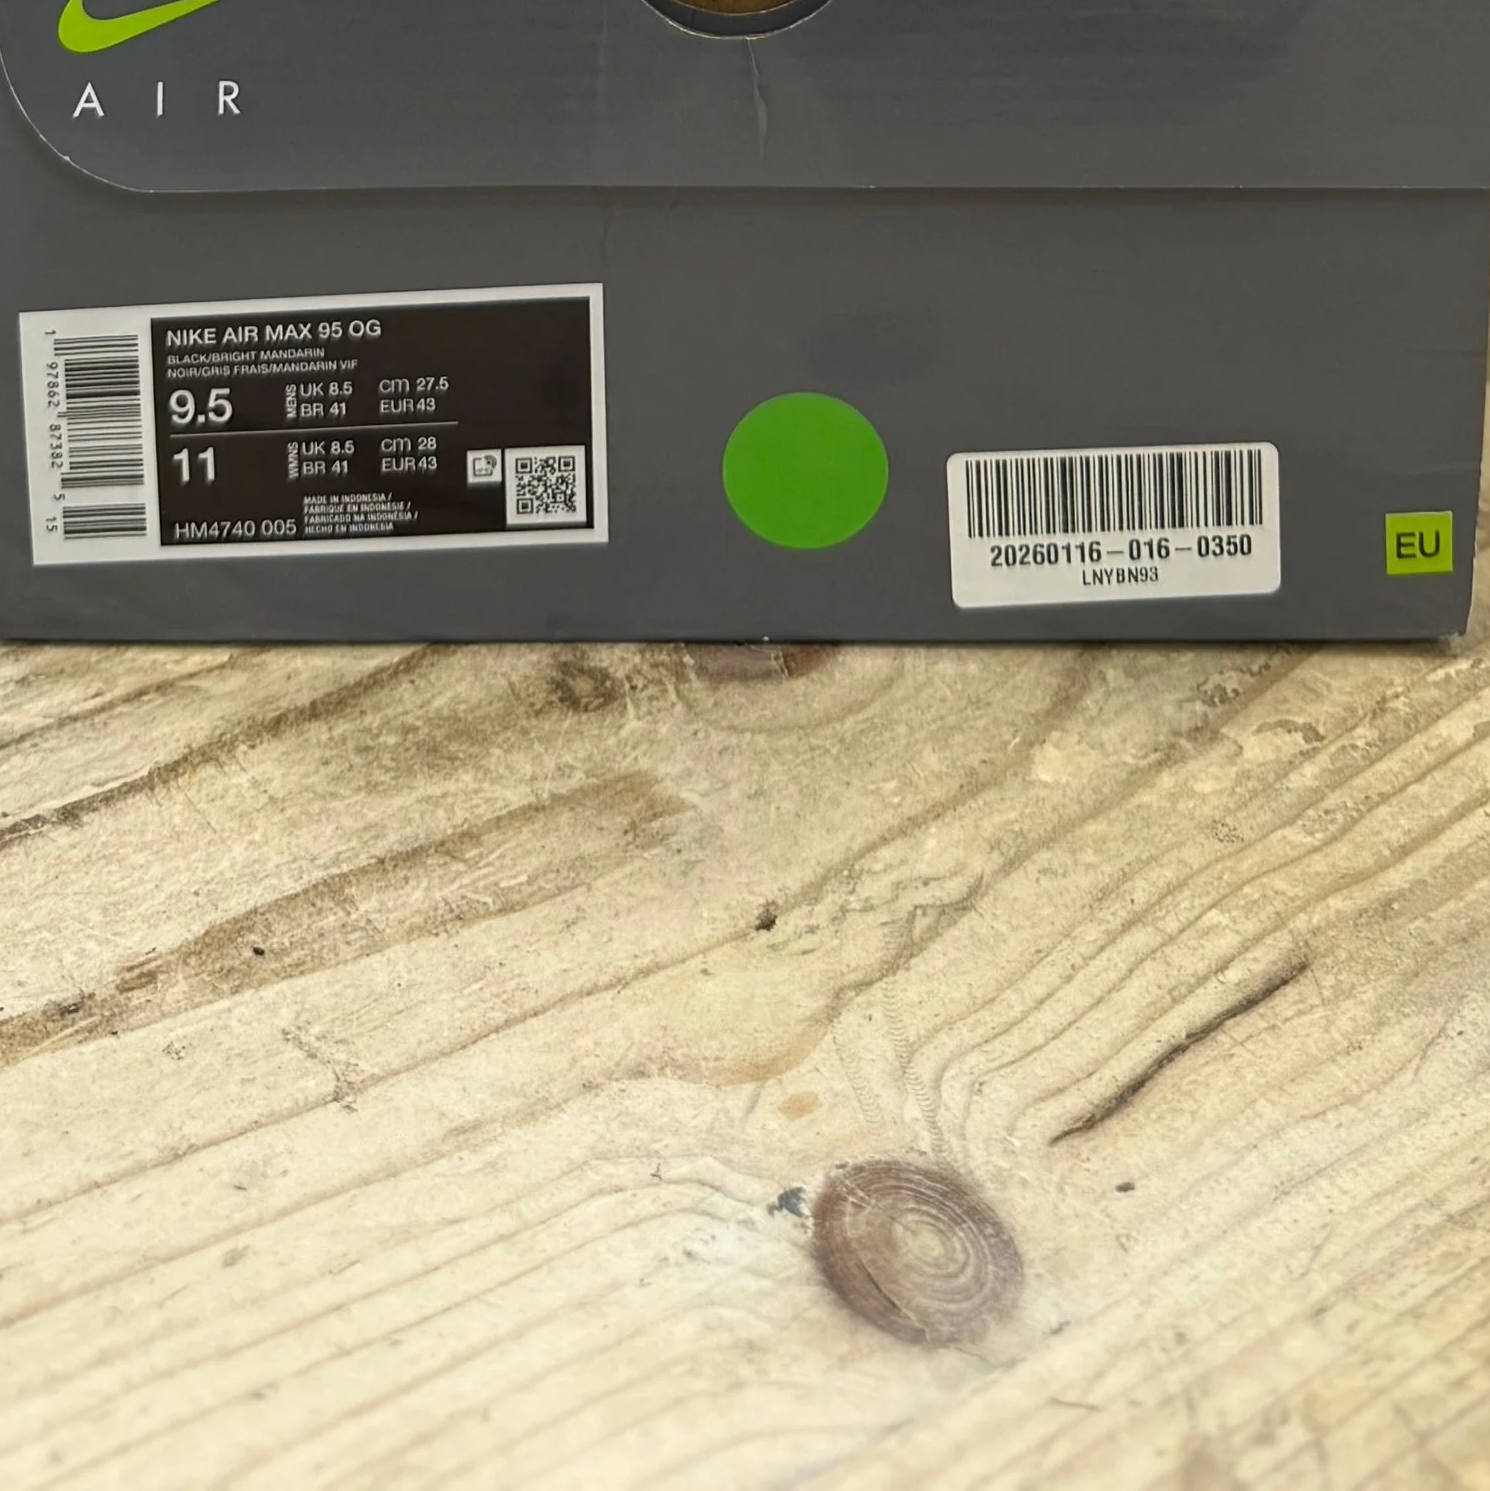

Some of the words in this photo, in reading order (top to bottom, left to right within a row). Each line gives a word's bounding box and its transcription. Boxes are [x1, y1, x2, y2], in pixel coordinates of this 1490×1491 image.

[71, 80, 241, 118] AIR
[166, 328, 217, 347] NIKE
[222, 325, 259, 344] AIR
[265, 323, 312, 341] MAX
[318, 321, 343, 338] 95
[348, 319, 382, 337] OG
[167, 350, 257, 365] BLACK/BRIGHT
[260, 347, 325, 360] MANDARIN
[167, 365, 231, 379] NOIR/GRIS
[234, 360, 337, 375] FRAIS/MANDARIN
[339, 359, 358, 370] VIF
[46, 361, 60, 408] 97862
[300, 383, 324, 397] UK
[329, 381, 353, 395] 8.5
[416, 376, 449, 392] 27.5
[169, 388, 233, 424] 9.5
[285, 384, 298, 418] MENS
[300, 403, 324, 417] BR
[329, 401, 347, 416] 41
[380, 399, 414, 414] EUR
[417, 397, 436, 412] 43
[49, 423, 64, 469] 87382
[301, 441, 326, 456] UK
[330, 440, 355, 455] 8.5
[417, 436, 437, 451] 28
[172, 446, 215, 483] 11
[288, 441, 299, 479] WMNS
[302, 461, 326, 476] BR
[331, 459, 349, 474] 41
[381, 457, 415, 473] EUR
[418, 455, 438, 470] 43
[304, 495, 327, 504] MADE
[330, 494, 339, 503] IN
[341, 493, 387, 503] INDONESIA
[347, 503, 358, 512] EN
[45, 516, 58, 532] 15
[304, 514, 351, 523] FABRICADO
[174, 520, 256, 540] HM4740
[261, 518, 297, 536] 005
[1395, 530, 1440, 559] EU
[1082, 567, 1159, 586] LNYBN93
